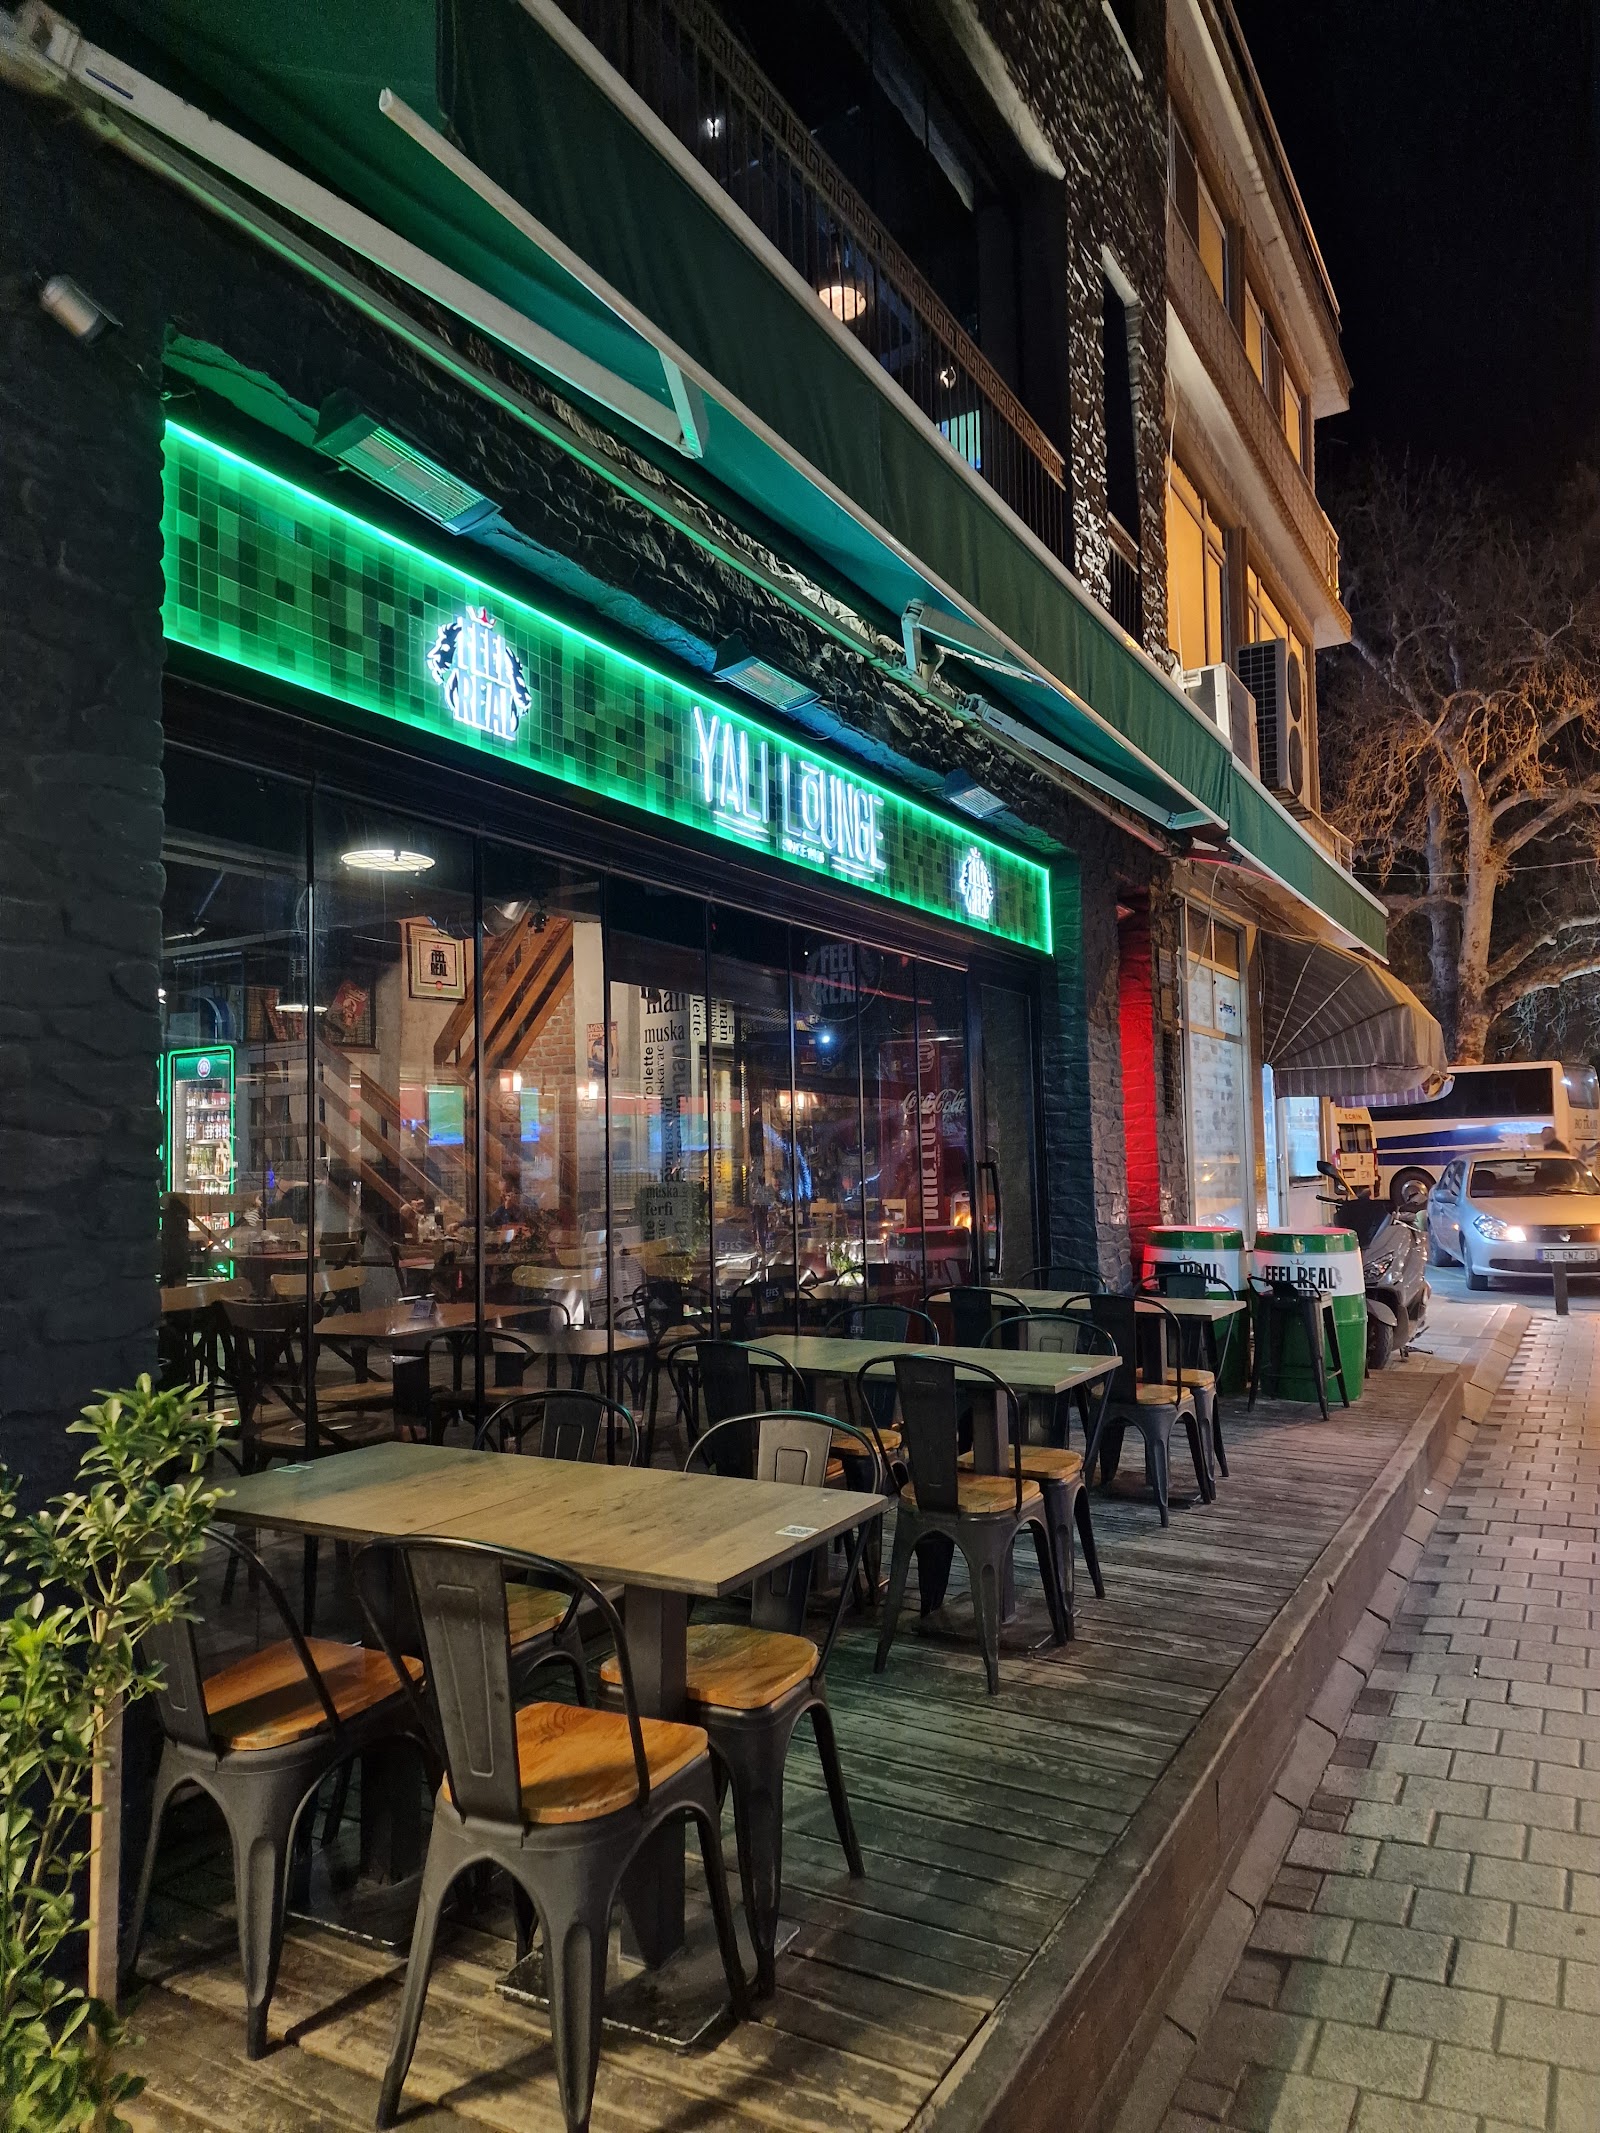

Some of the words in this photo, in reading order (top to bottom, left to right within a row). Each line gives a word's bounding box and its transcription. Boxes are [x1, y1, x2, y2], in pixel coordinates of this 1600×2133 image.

[456, 615, 513, 689] FEEL
[452, 668, 517, 742] REAL
[693, 705, 770, 824] YALI
[643, 1019, 685, 1044] muska
[643, 1046, 654, 1100] oilette
[1297, 1266, 1337, 1289] REAL
